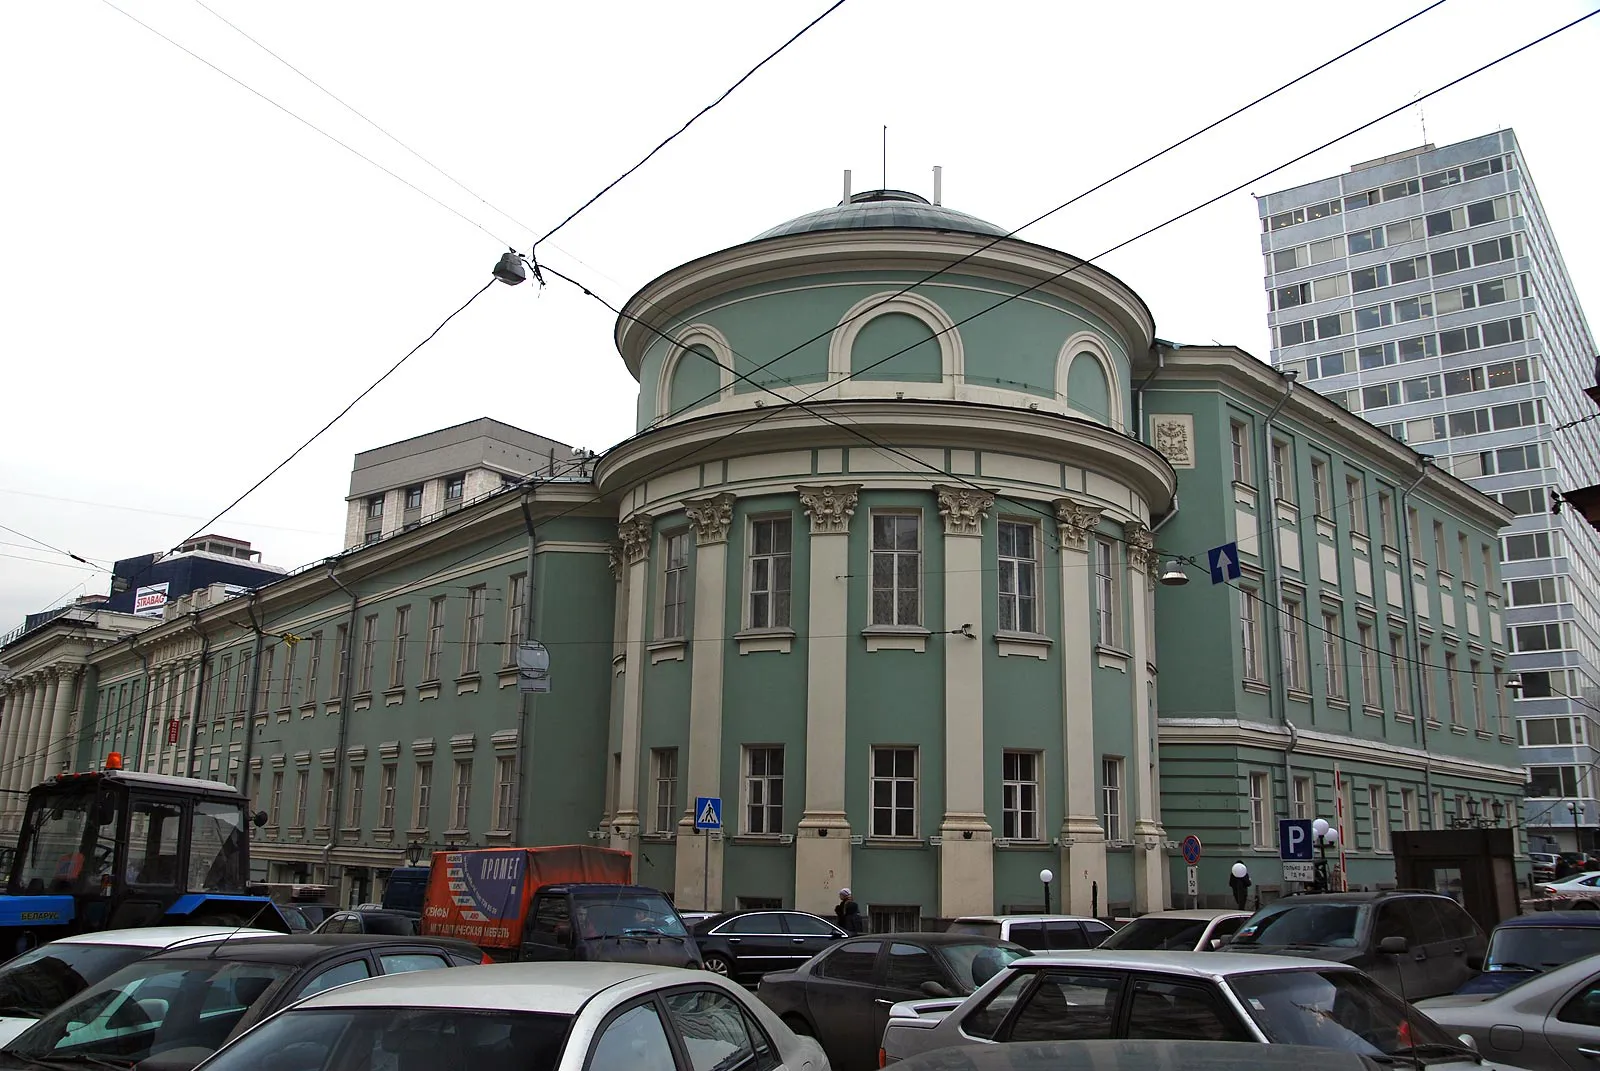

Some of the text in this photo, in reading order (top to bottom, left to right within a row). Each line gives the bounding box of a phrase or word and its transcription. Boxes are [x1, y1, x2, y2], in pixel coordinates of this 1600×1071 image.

[136, 594, 165, 608] STRABAG
[1288, 825, 1305, 854] P
[480, 857, 520, 880] ПРОМЕТ
[21, 912, 59, 920] БЕЛАРУС
[425, 904, 449, 918] СЕЙФЫ
